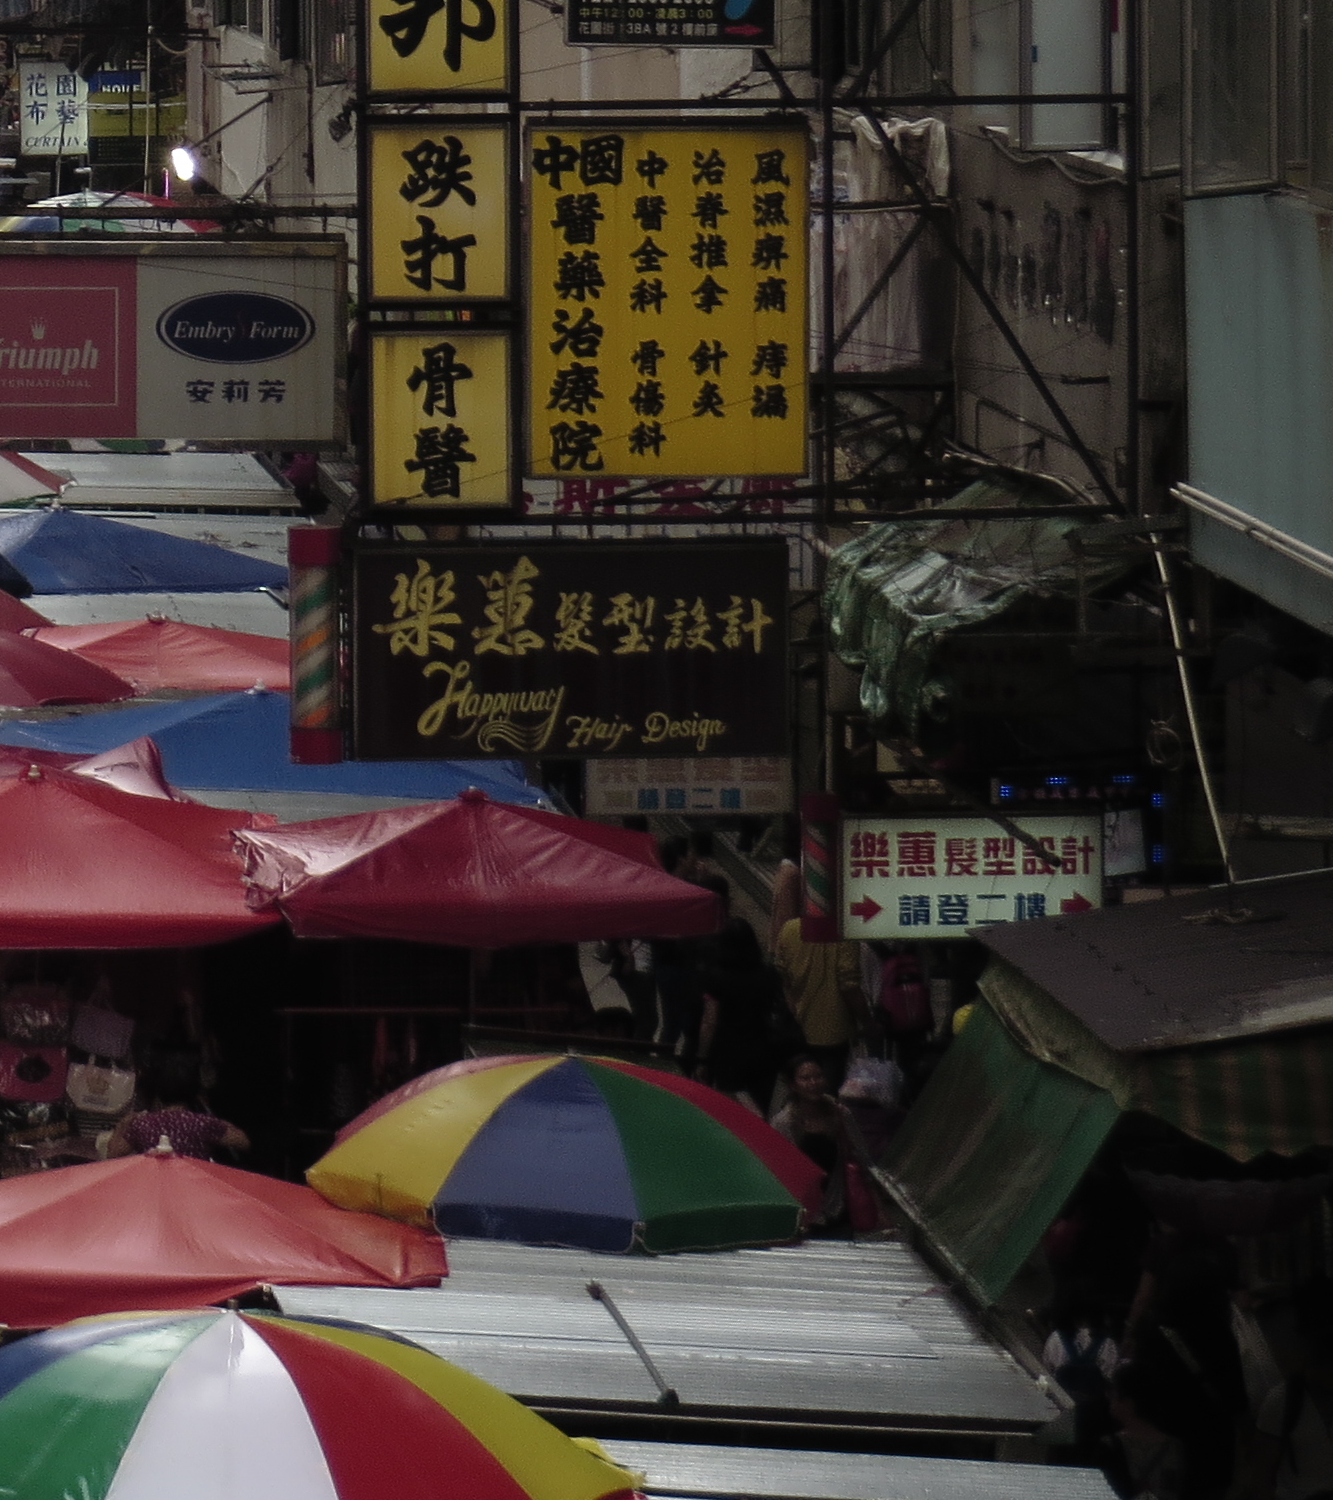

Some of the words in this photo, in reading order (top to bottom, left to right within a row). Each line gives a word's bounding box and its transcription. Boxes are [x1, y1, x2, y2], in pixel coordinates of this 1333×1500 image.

[25, 73, 77, 97] 花園
[25, 135, 81, 149] CURTAIN
[398, 134, 477, 292] 跌打
[628, 149, 669, 315] 中醫全科
[689, 148, 730, 314] 治脊推拿
[173, 318, 238, 346] Embry
[247, 318, 303, 342] Form
[185, 379, 287, 404] 安莉芳
[404, 340, 477, 499] 骨醫
[627, 340, 666, 459] 骨傷科
[688, 339, 729, 418] 針灸
[416, 660, 567, 752] Happyway
[566, 713, 634, 751] Hair
[640, 711, 727, 752] Design
